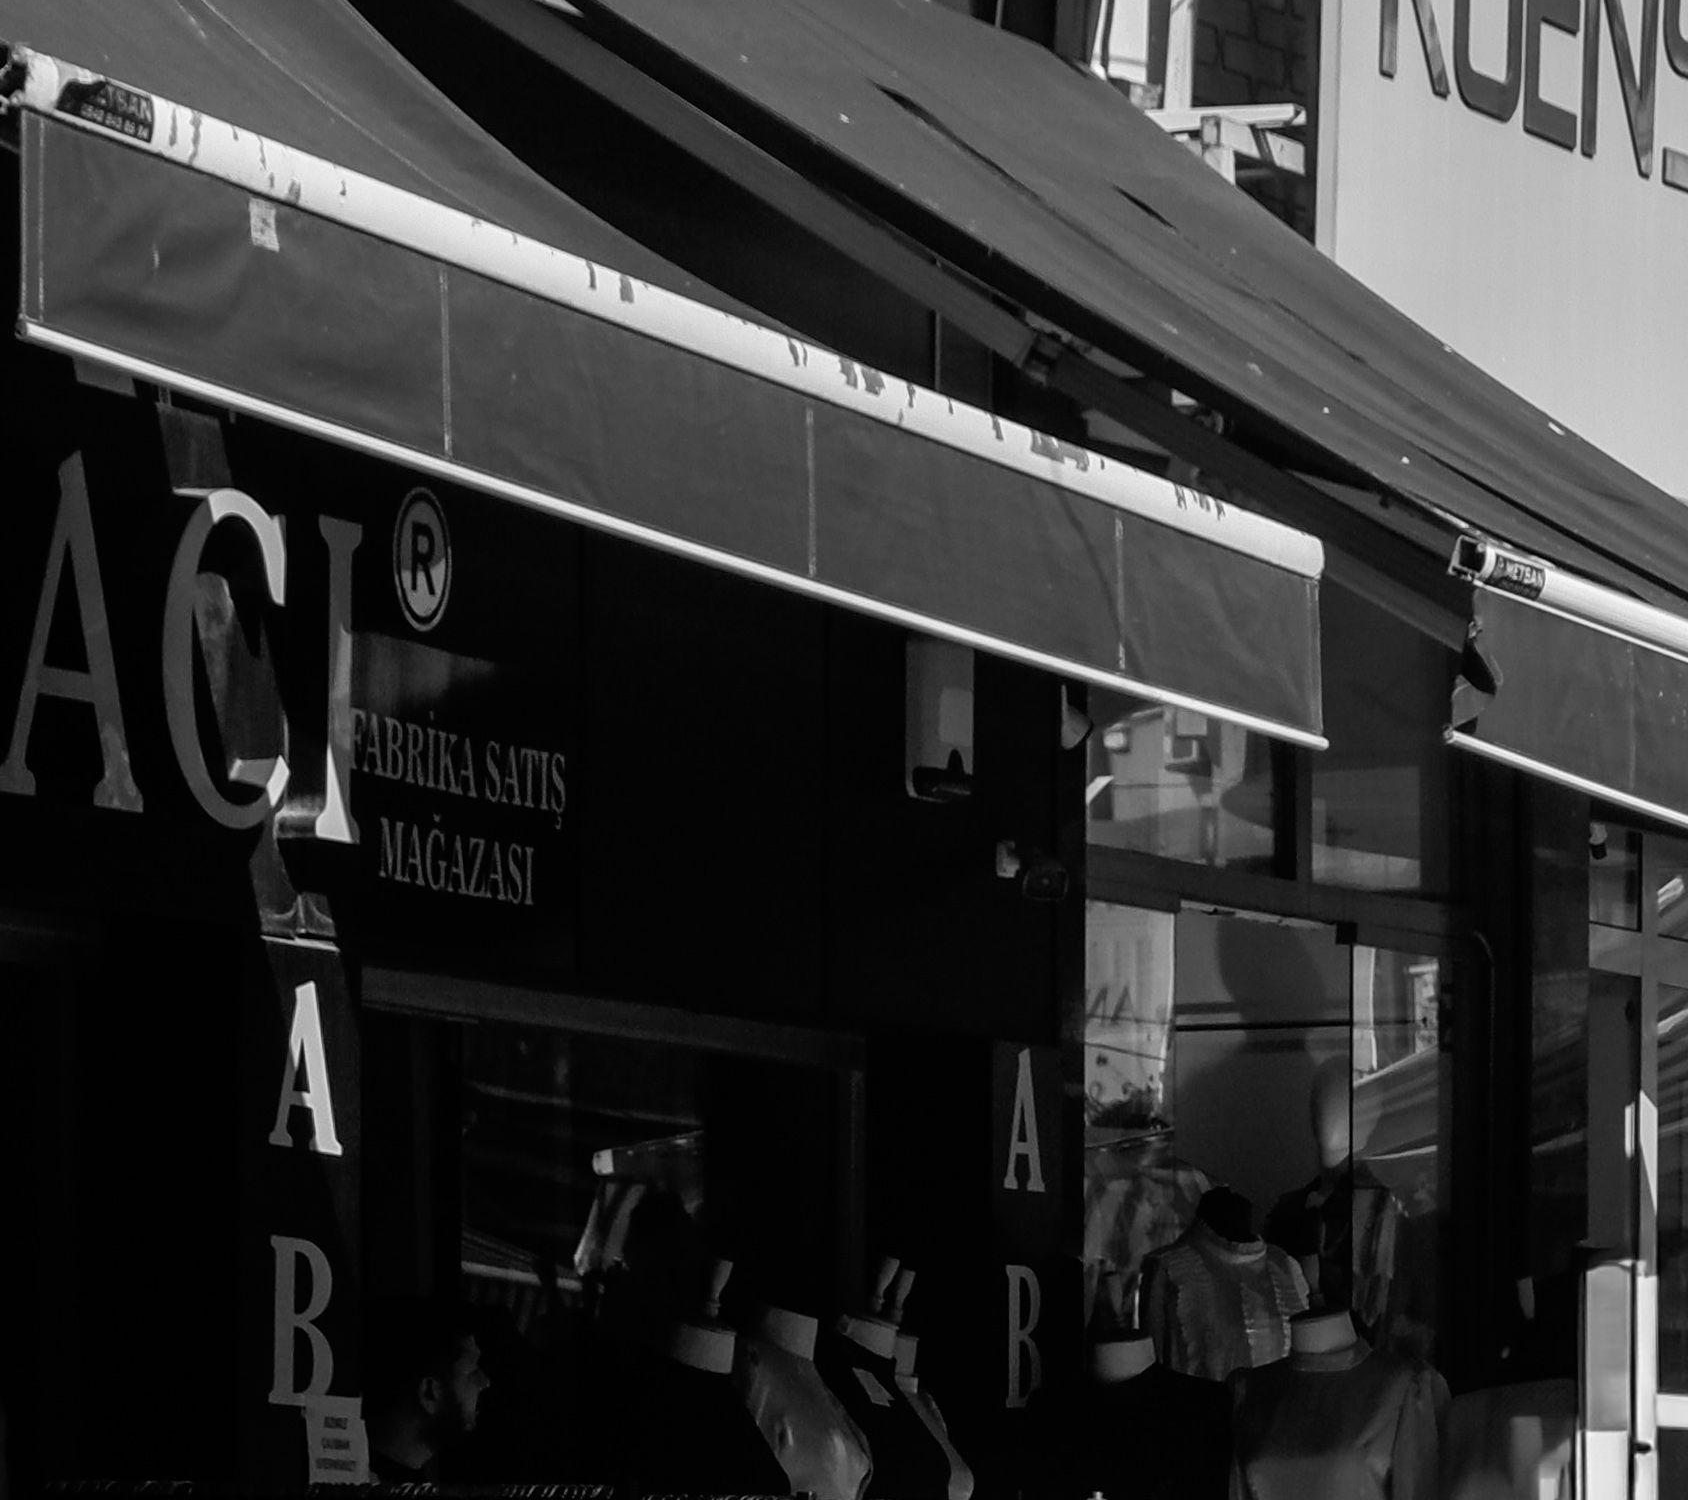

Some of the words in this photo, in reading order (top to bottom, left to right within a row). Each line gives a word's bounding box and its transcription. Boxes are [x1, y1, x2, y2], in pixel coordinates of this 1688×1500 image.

[349, 708, 477, 795] FABRİKA
[485, 740, 567, 831] SATIŞ
[379, 813, 535, 906] MAĞAZASI
